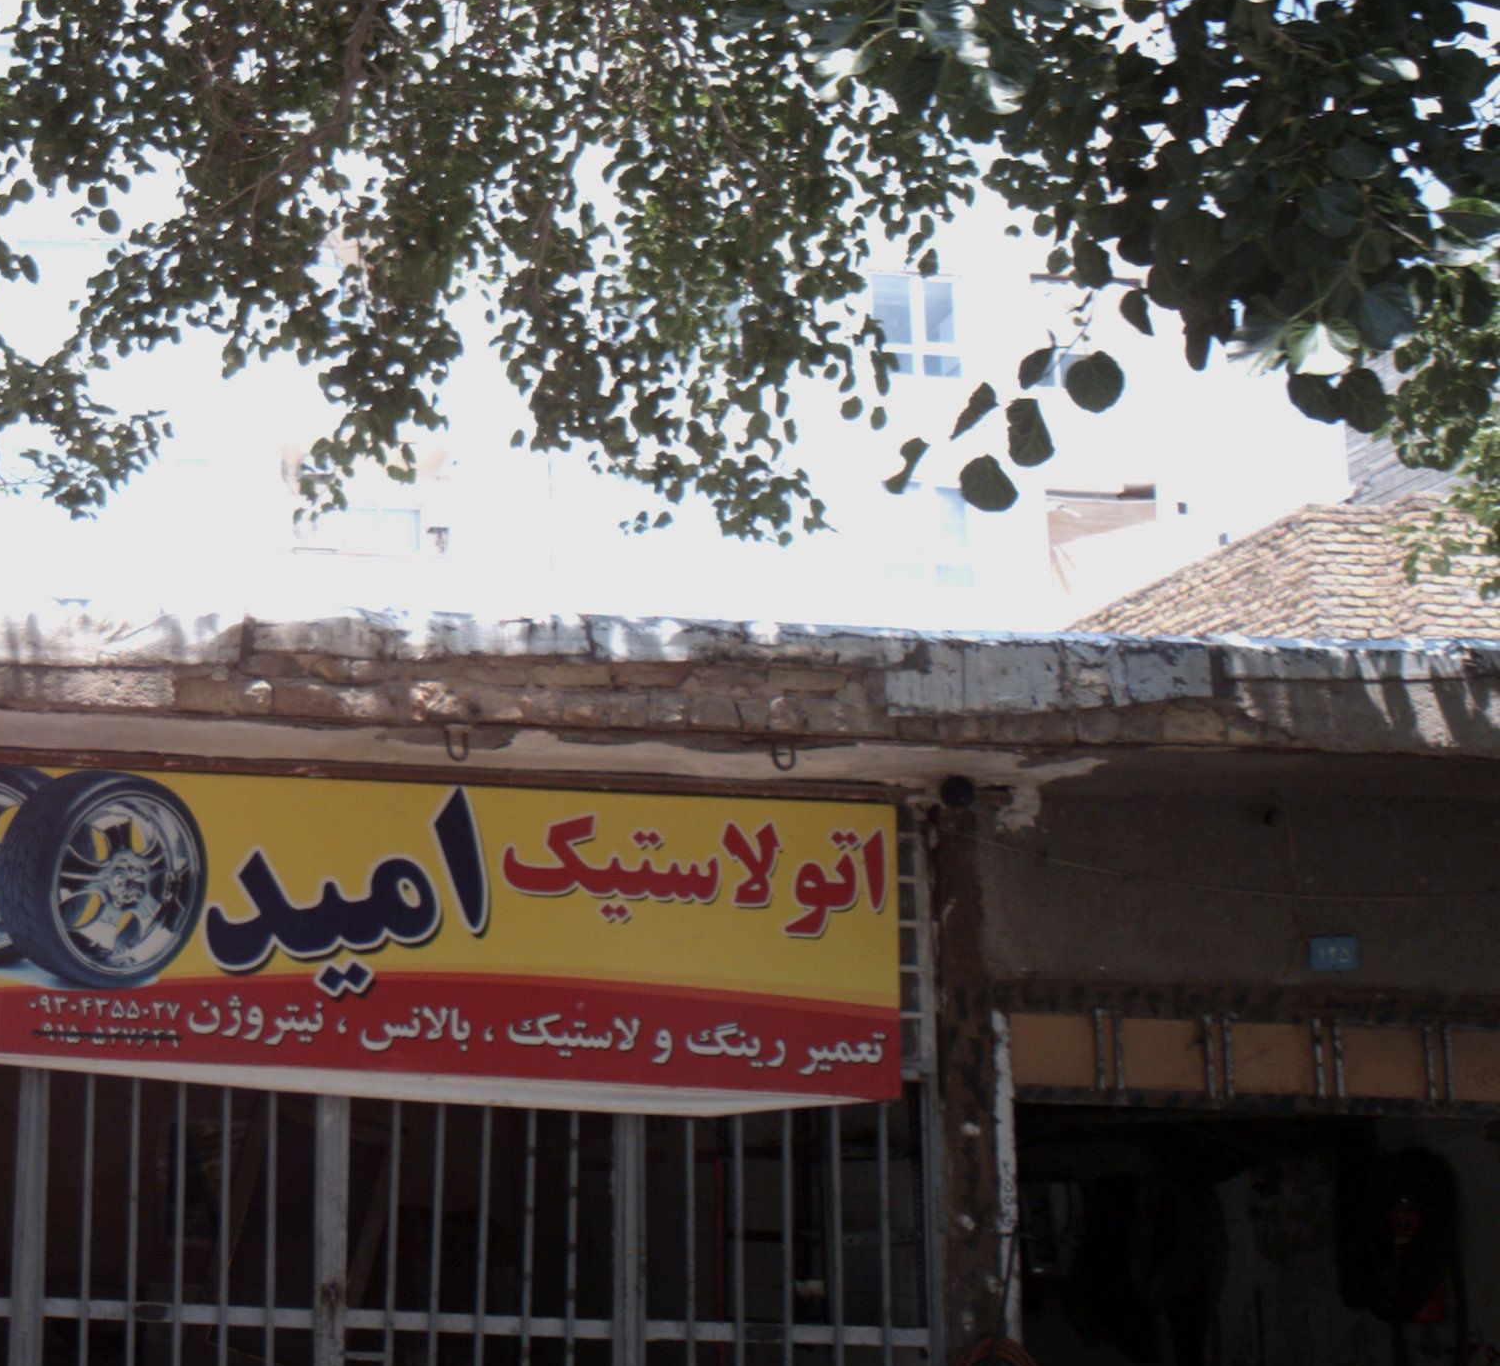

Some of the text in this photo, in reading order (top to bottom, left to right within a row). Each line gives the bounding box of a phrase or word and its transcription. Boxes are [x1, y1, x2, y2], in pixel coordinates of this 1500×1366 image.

[203, 783, 490, 997] امید
[28, 993, 181, 1021] ۰۹۳۰۴۳۵۵۰۲۷
[186, 994, 324, 1046] نیتروژن
[359, 1004, 472, 1052] بالانس
[507, 1011, 641, 1059] لاستیک
[651, 1026, 674, 1065] و
[684, 1021, 787, 1069] رینگ
[797, 1031, 886, 1075] تعمیر
